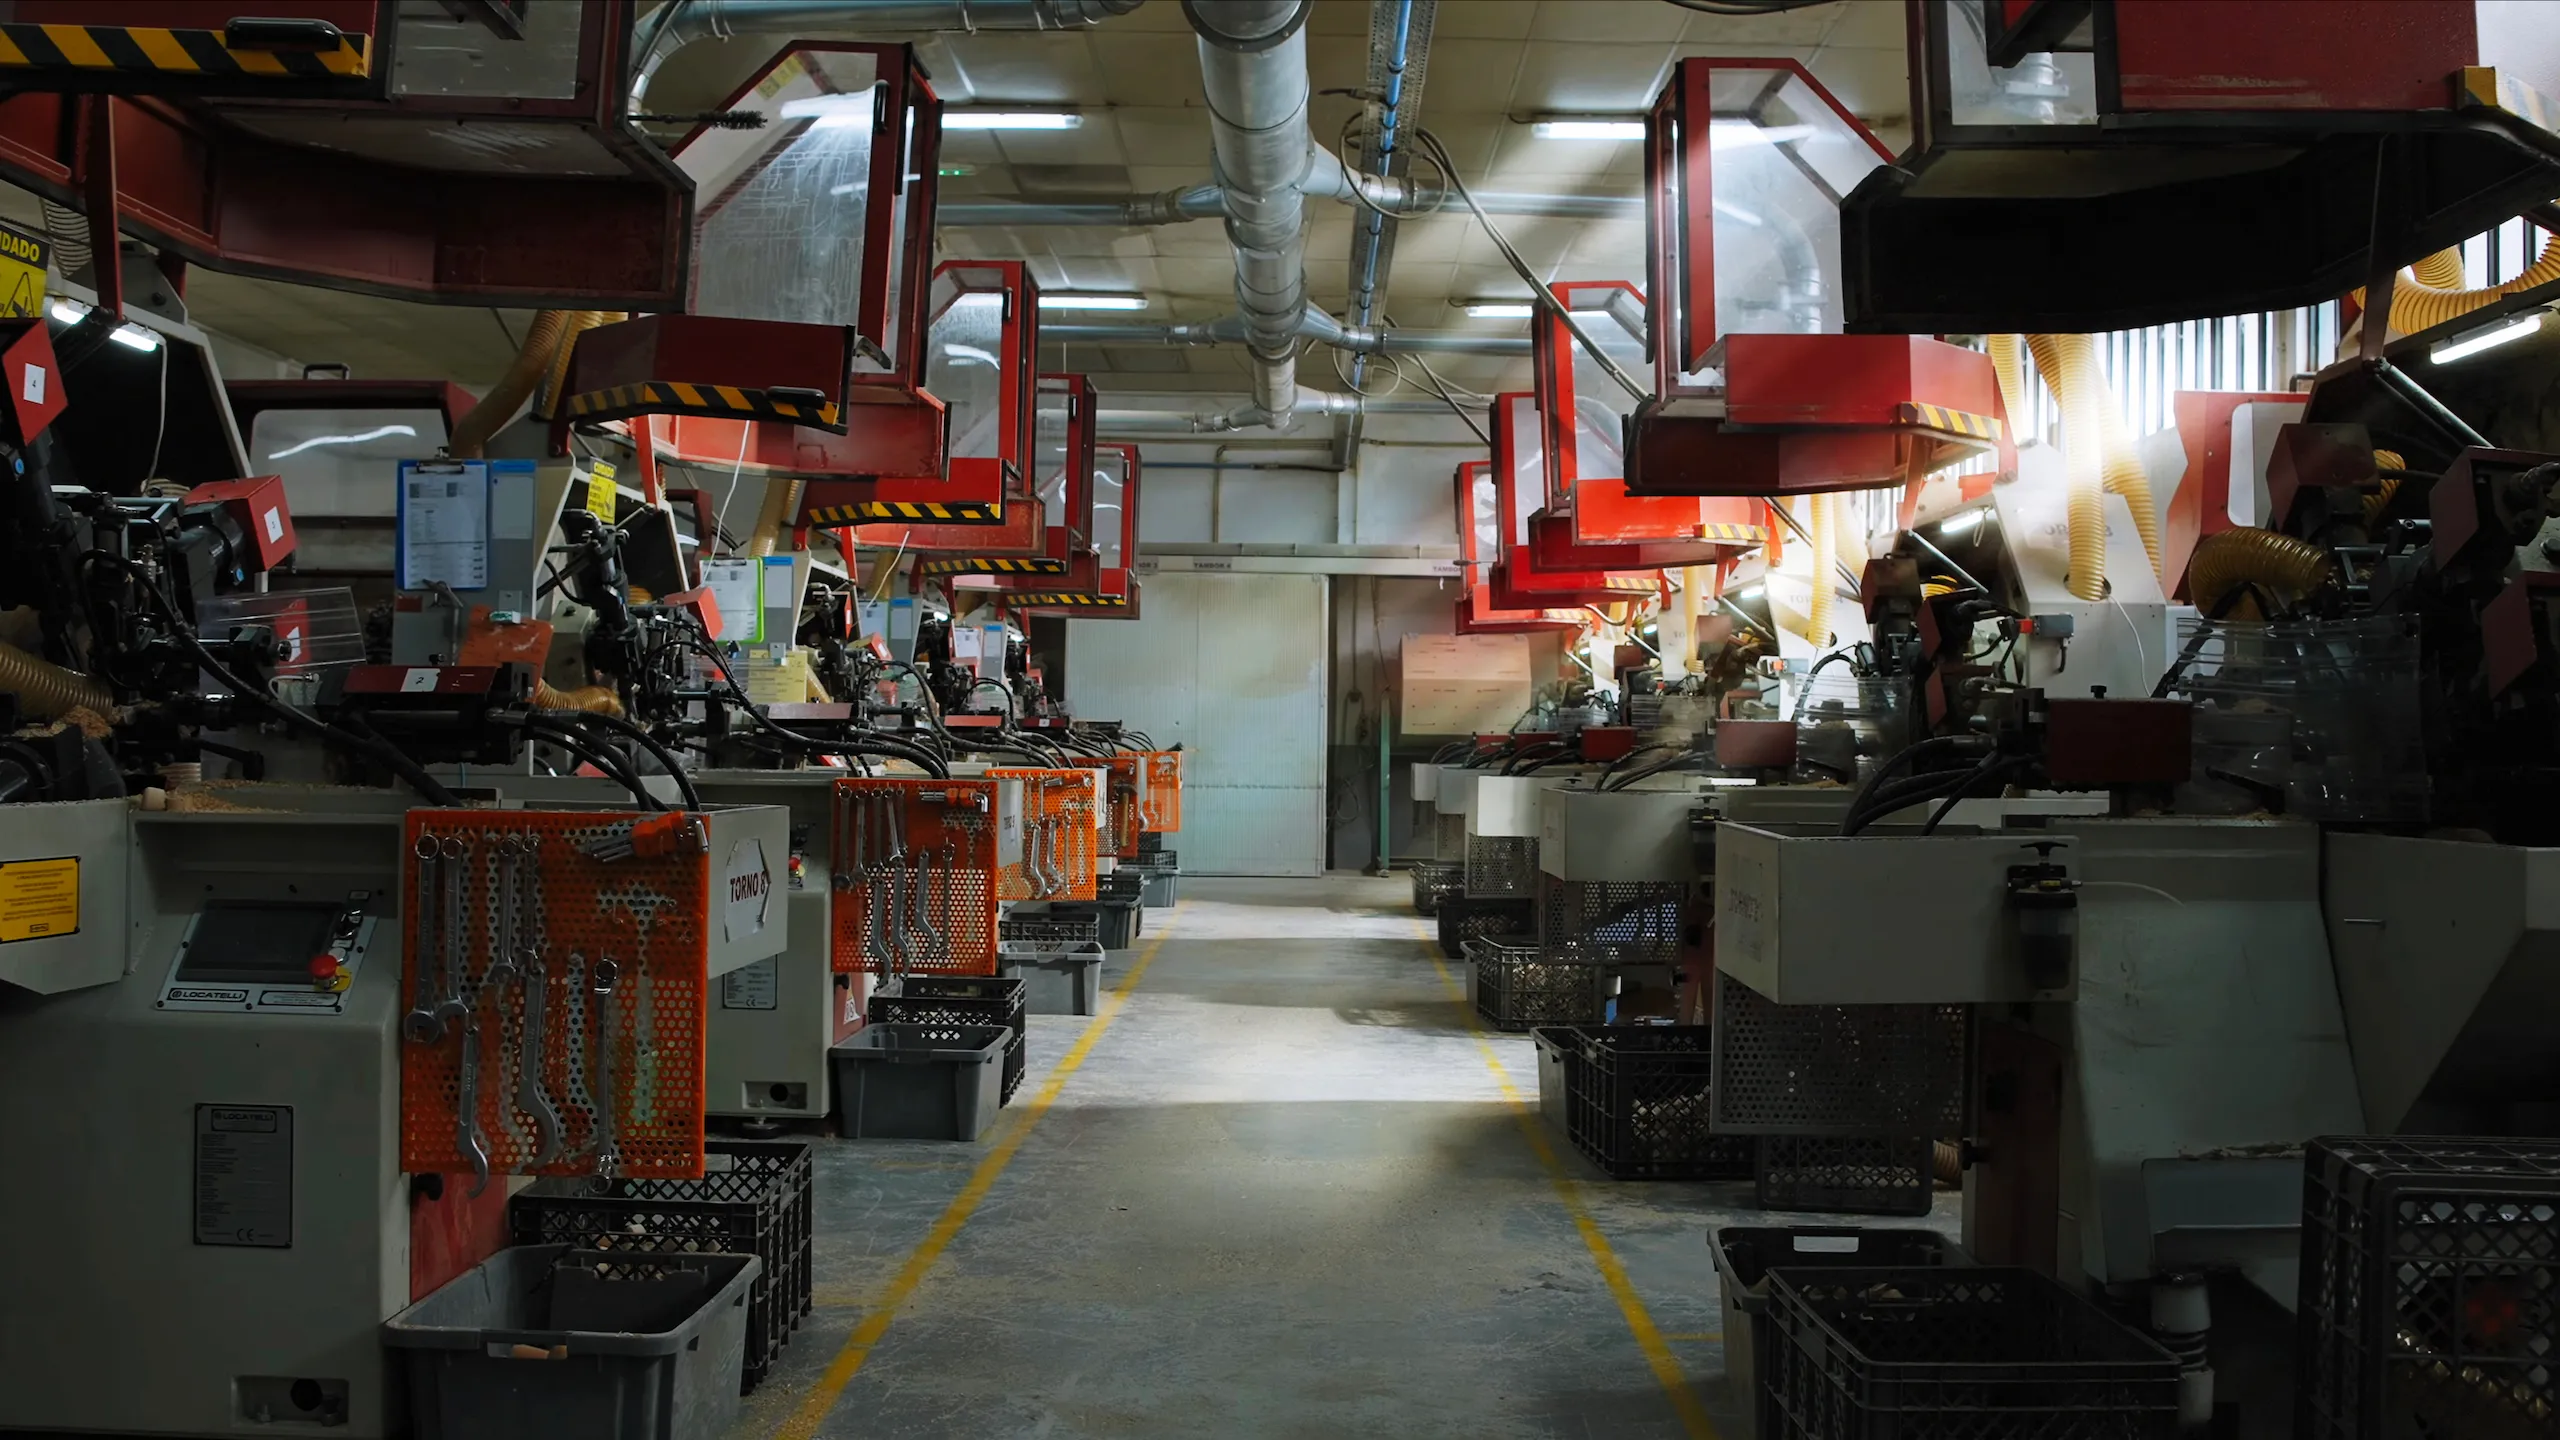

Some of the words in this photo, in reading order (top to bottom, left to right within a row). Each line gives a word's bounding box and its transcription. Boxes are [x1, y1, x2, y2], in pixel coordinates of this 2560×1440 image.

[730, 872, 759, 903] TORNO
[760, 870, 766, 895] 8
[182, 990, 243, 999] LOCATELLI
[222, 1112, 273, 1122] LOCATELLI
